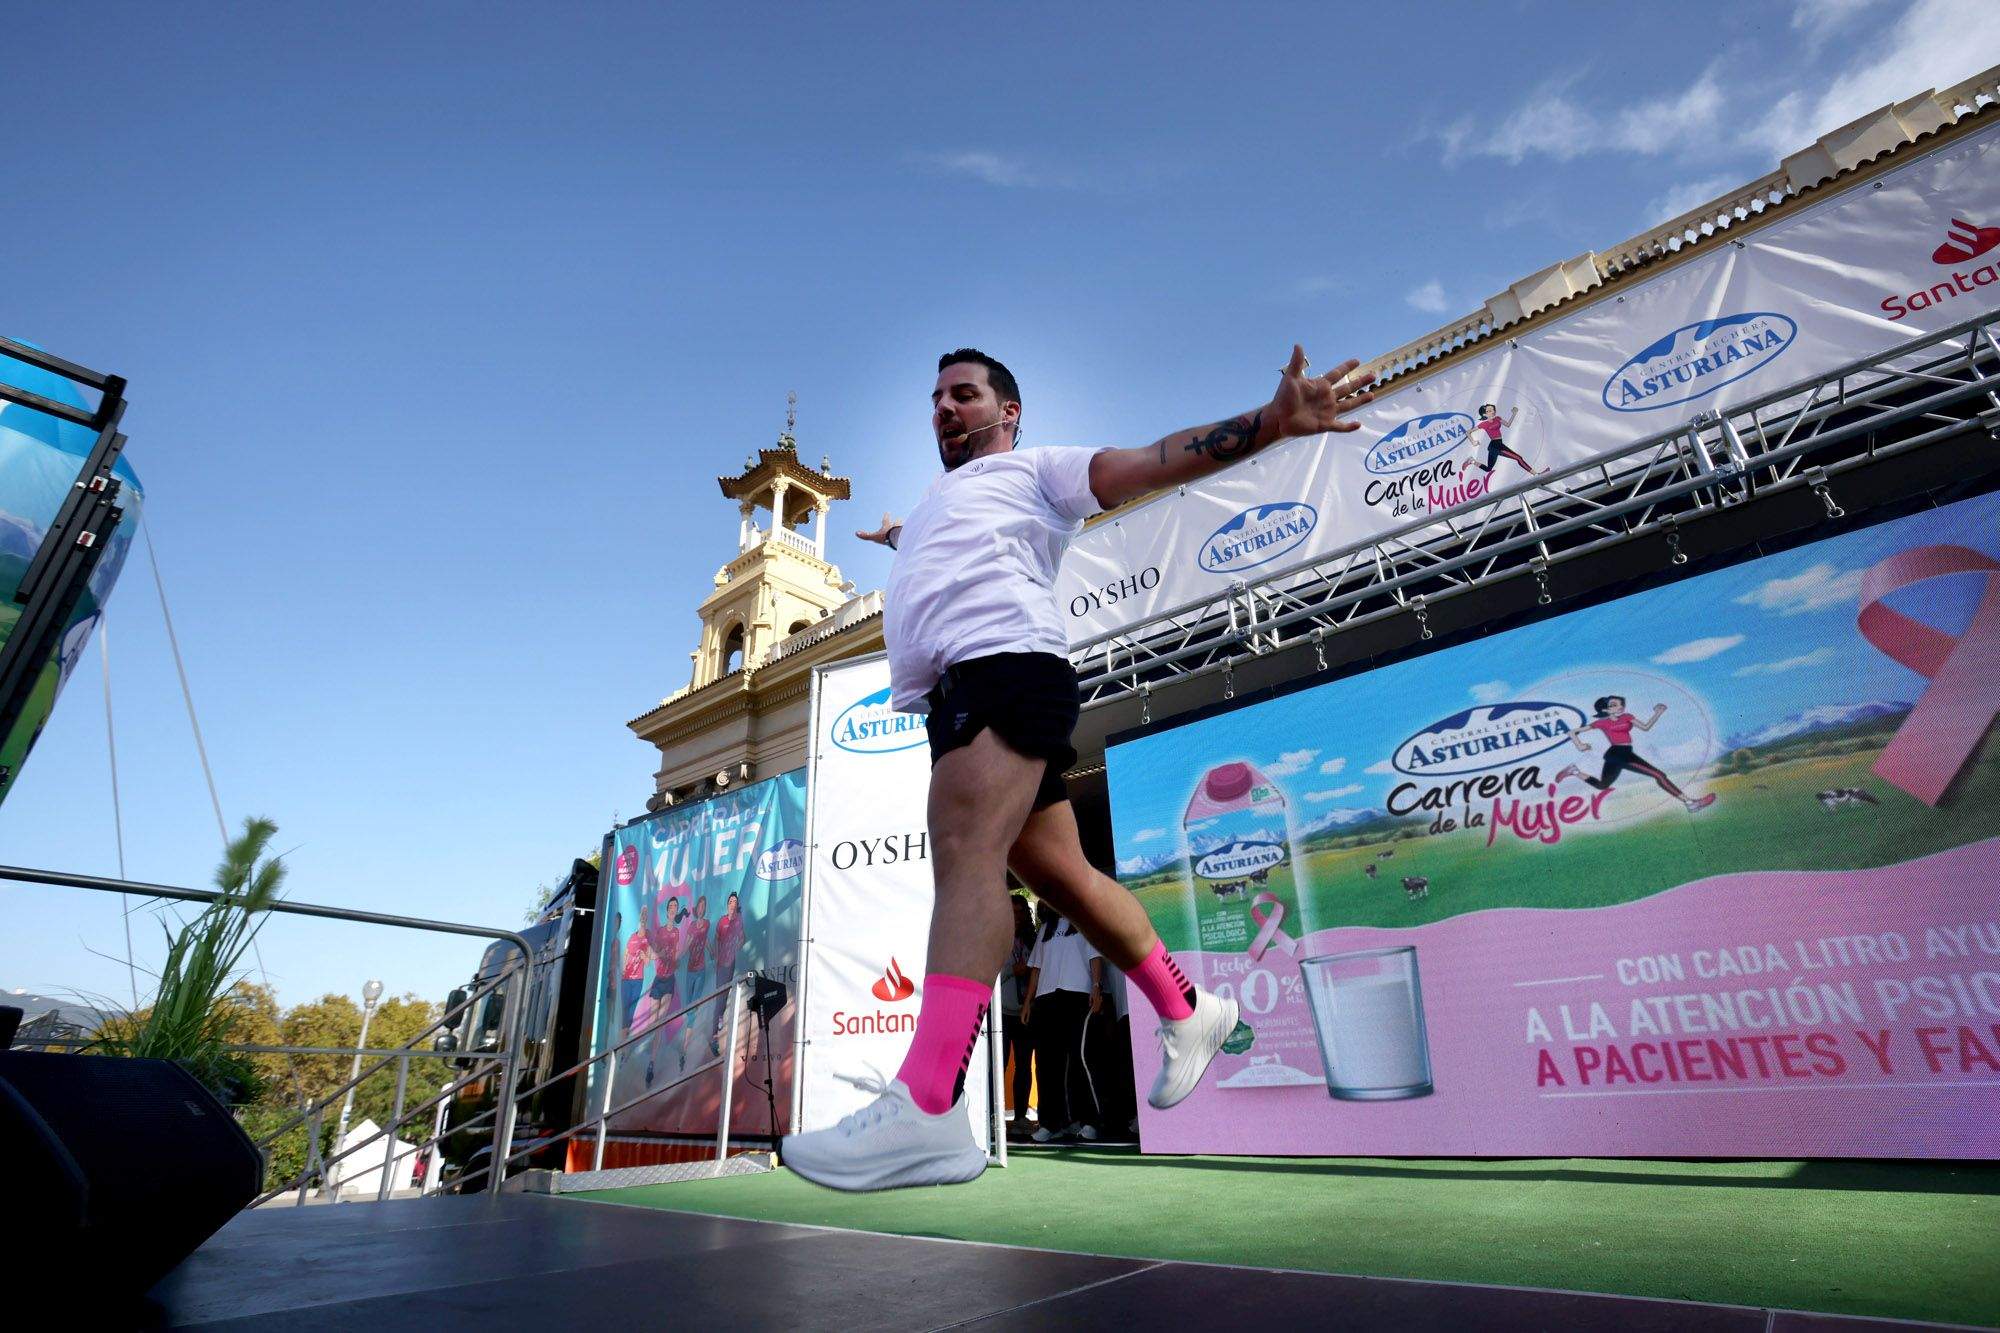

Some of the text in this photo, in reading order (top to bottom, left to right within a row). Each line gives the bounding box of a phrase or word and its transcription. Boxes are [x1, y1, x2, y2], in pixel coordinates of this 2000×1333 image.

[1881, 261, 2000, 321] Santa
[1620, 328, 1784, 406] ASTURIANA
[1640, 320, 1768, 377] CENTRAL LECHERA
[1374, 423, 1467, 470] ASTURIANA
[1364, 459, 1456, 506] Carrera
[1392, 499, 1409, 517] de
[1412, 493, 1426, 511] la
[1208, 517, 1311, 568] ASTURIANA
[1070, 567, 1160, 617] OYSHO
[1408, 718, 1572, 769] ASTURIANA
[1430, 710, 1560, 745] CENTRAL LECHERA
[1387, 765, 1544, 816] Carrera
[1429, 781, 1615, 848] de la Mujer
[642, 822, 762, 895] MUJER
[832, 831, 927, 870] OYSH
[1202, 852, 1279, 874] ASTURIANA
[1616, 954, 1685, 986] CON
[1694, 944, 1790, 980] CADA
[1796, 931, 1910, 971] LITRO
[832, 1010, 919, 1036] Santan
[1525, 1007, 1553, 1043] A
[1560, 1001, 1617, 1041] LA
[1629, 971, 1865, 1037] ATENCIÓN
[1536, 1023, 2000, 1087] A PACIENTES Y FA
